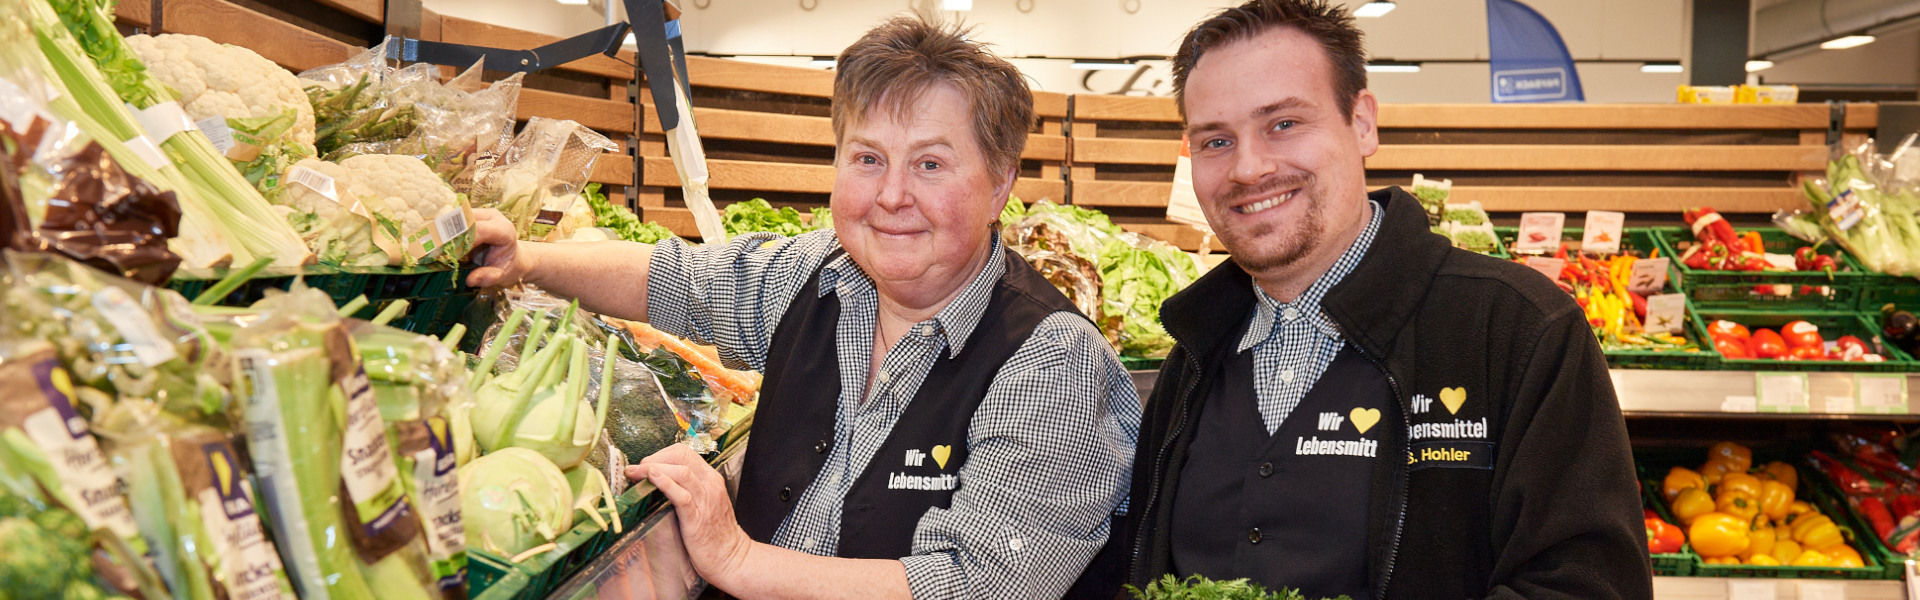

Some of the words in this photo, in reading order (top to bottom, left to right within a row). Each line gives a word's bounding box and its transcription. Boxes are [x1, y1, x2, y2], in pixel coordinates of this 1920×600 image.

[1317, 412, 1345, 431] Wir
[1295, 436, 1378, 458] Lebensmitt
[1421, 448, 1471, 462] Hohler
[904, 449, 926, 467] Wir
[887, 471, 959, 491] Lebensmitte
